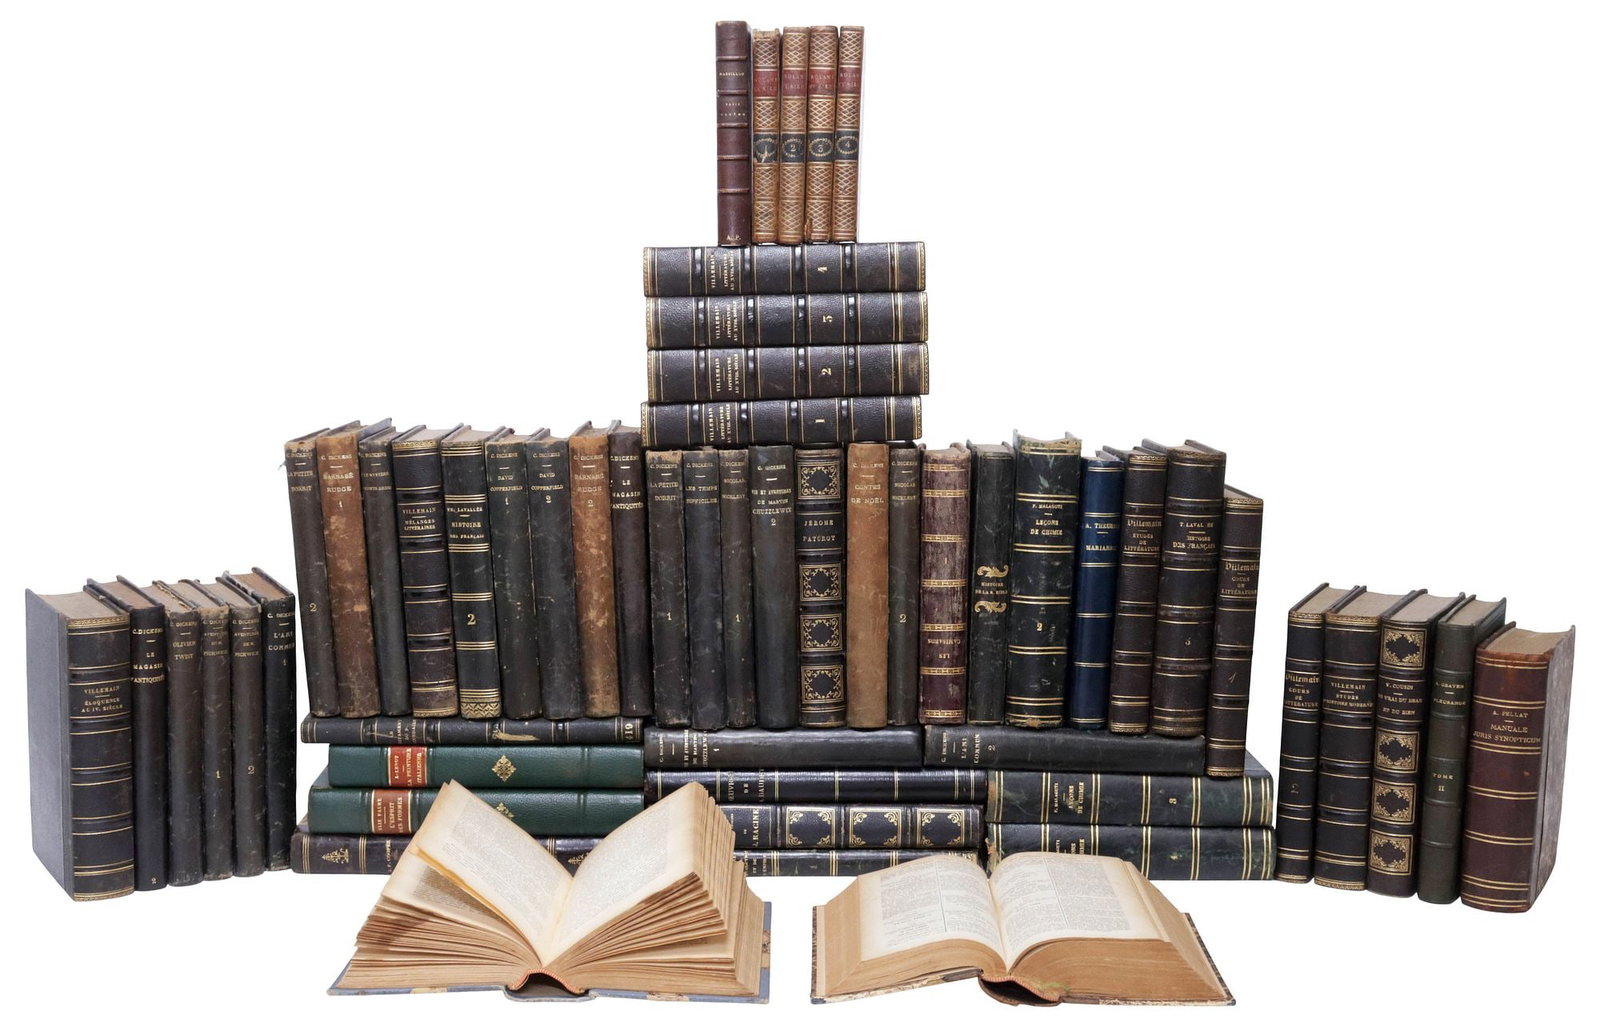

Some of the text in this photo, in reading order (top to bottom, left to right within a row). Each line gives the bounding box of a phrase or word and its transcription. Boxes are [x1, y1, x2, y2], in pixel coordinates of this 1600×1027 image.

[821, 368, 831, 376] 2
[546, 495, 551, 503] 2
[310, 603, 317, 612] 2
[467, 614, 476, 625] 2
[667, 612, 672, 620] 1
[736, 614, 740, 622] 1
[900, 614, 906, 622] 2
[1036, 622, 1043, 631] 2
[84, 686, 120, 694] VILLEMAIN
[1491, 724, 1528, 733] MANUALE
[1473, 731, 1492, 739] JURIS
[248, 766, 254, 774] 2
[744, 783, 749, 794] DE
